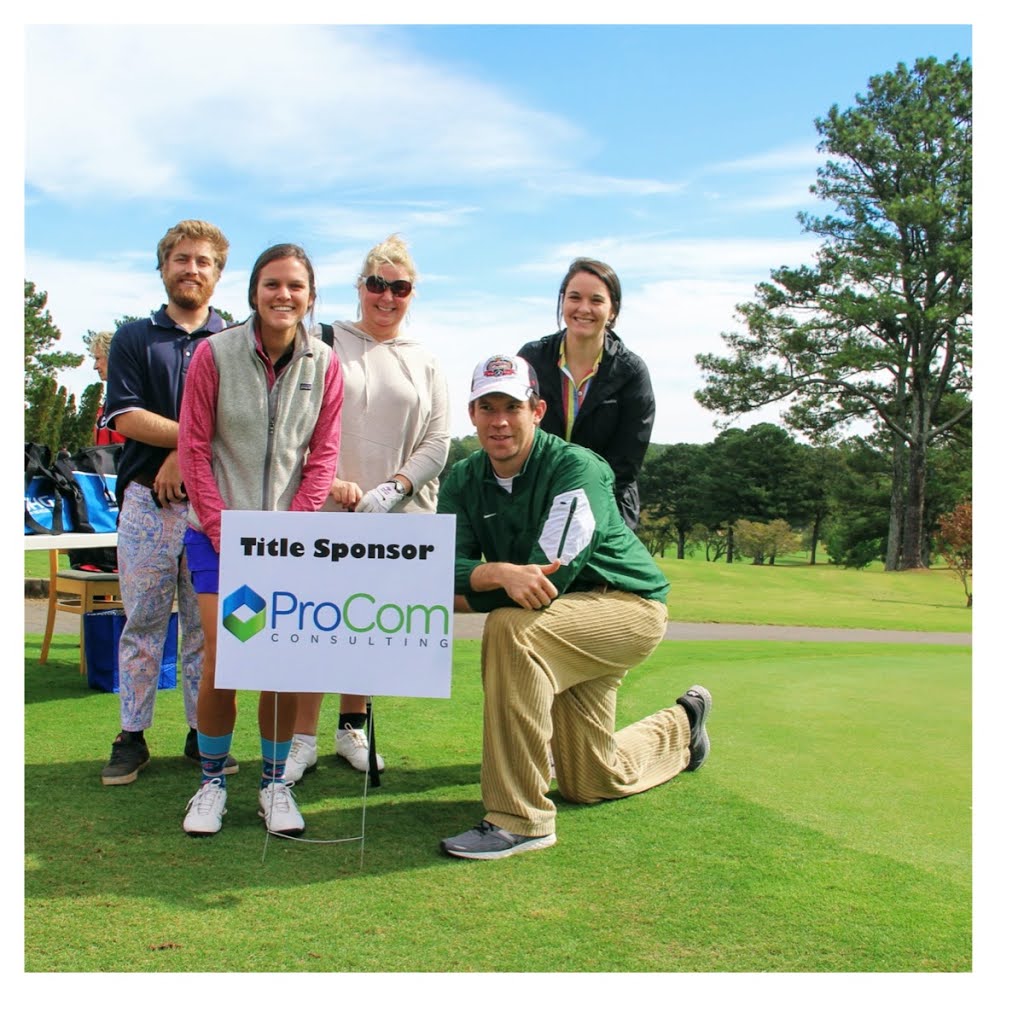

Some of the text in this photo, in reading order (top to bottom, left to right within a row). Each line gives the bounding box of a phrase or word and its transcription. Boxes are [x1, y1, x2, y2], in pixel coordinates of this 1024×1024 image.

[240, 537, 435, 562] Title Sponsor
[271, 591, 449, 635] ProCom
[271, 633, 449, 648] CONSULTING
